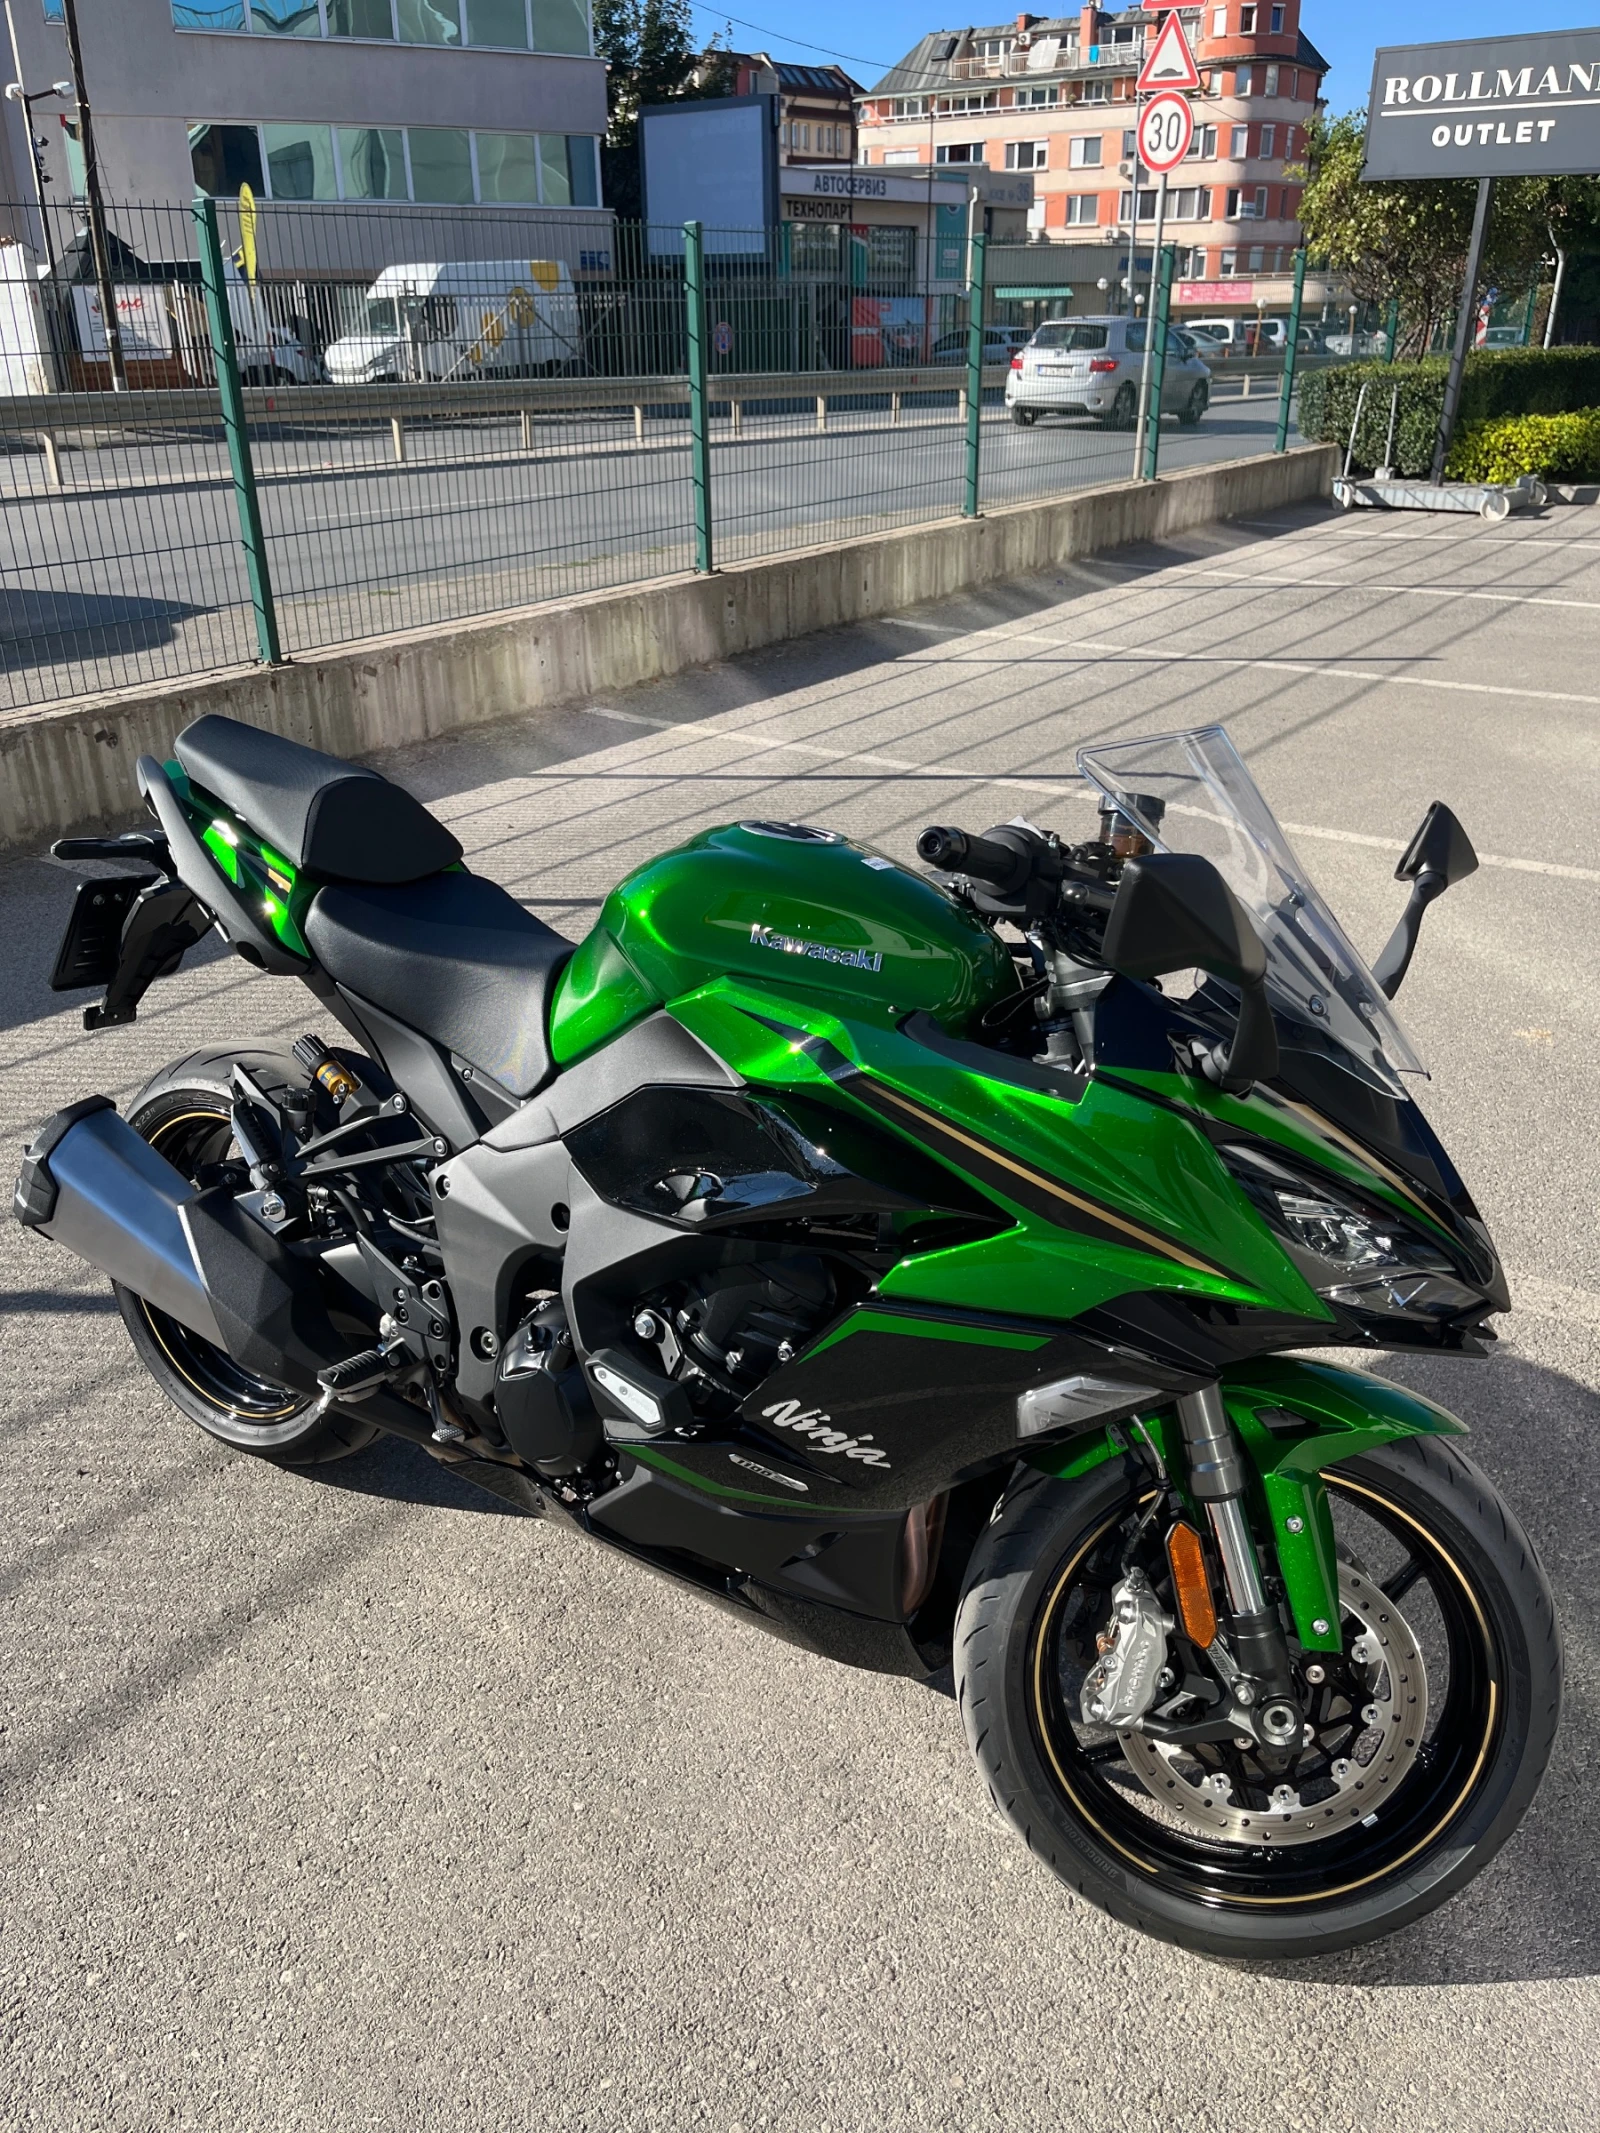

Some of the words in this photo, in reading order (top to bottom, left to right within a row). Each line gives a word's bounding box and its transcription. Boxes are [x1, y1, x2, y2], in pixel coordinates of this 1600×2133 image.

[1382, 62, 1600, 106] ROLLMAN
[1148, 112, 1182, 152] 30
[1431, 120, 1556, 147] OUTLET
[813, 174, 887, 196] АВТОСЕРВИЗ
[750, 923, 884, 972] Kawasaki
[761, 1399, 892, 1468] Ninja
